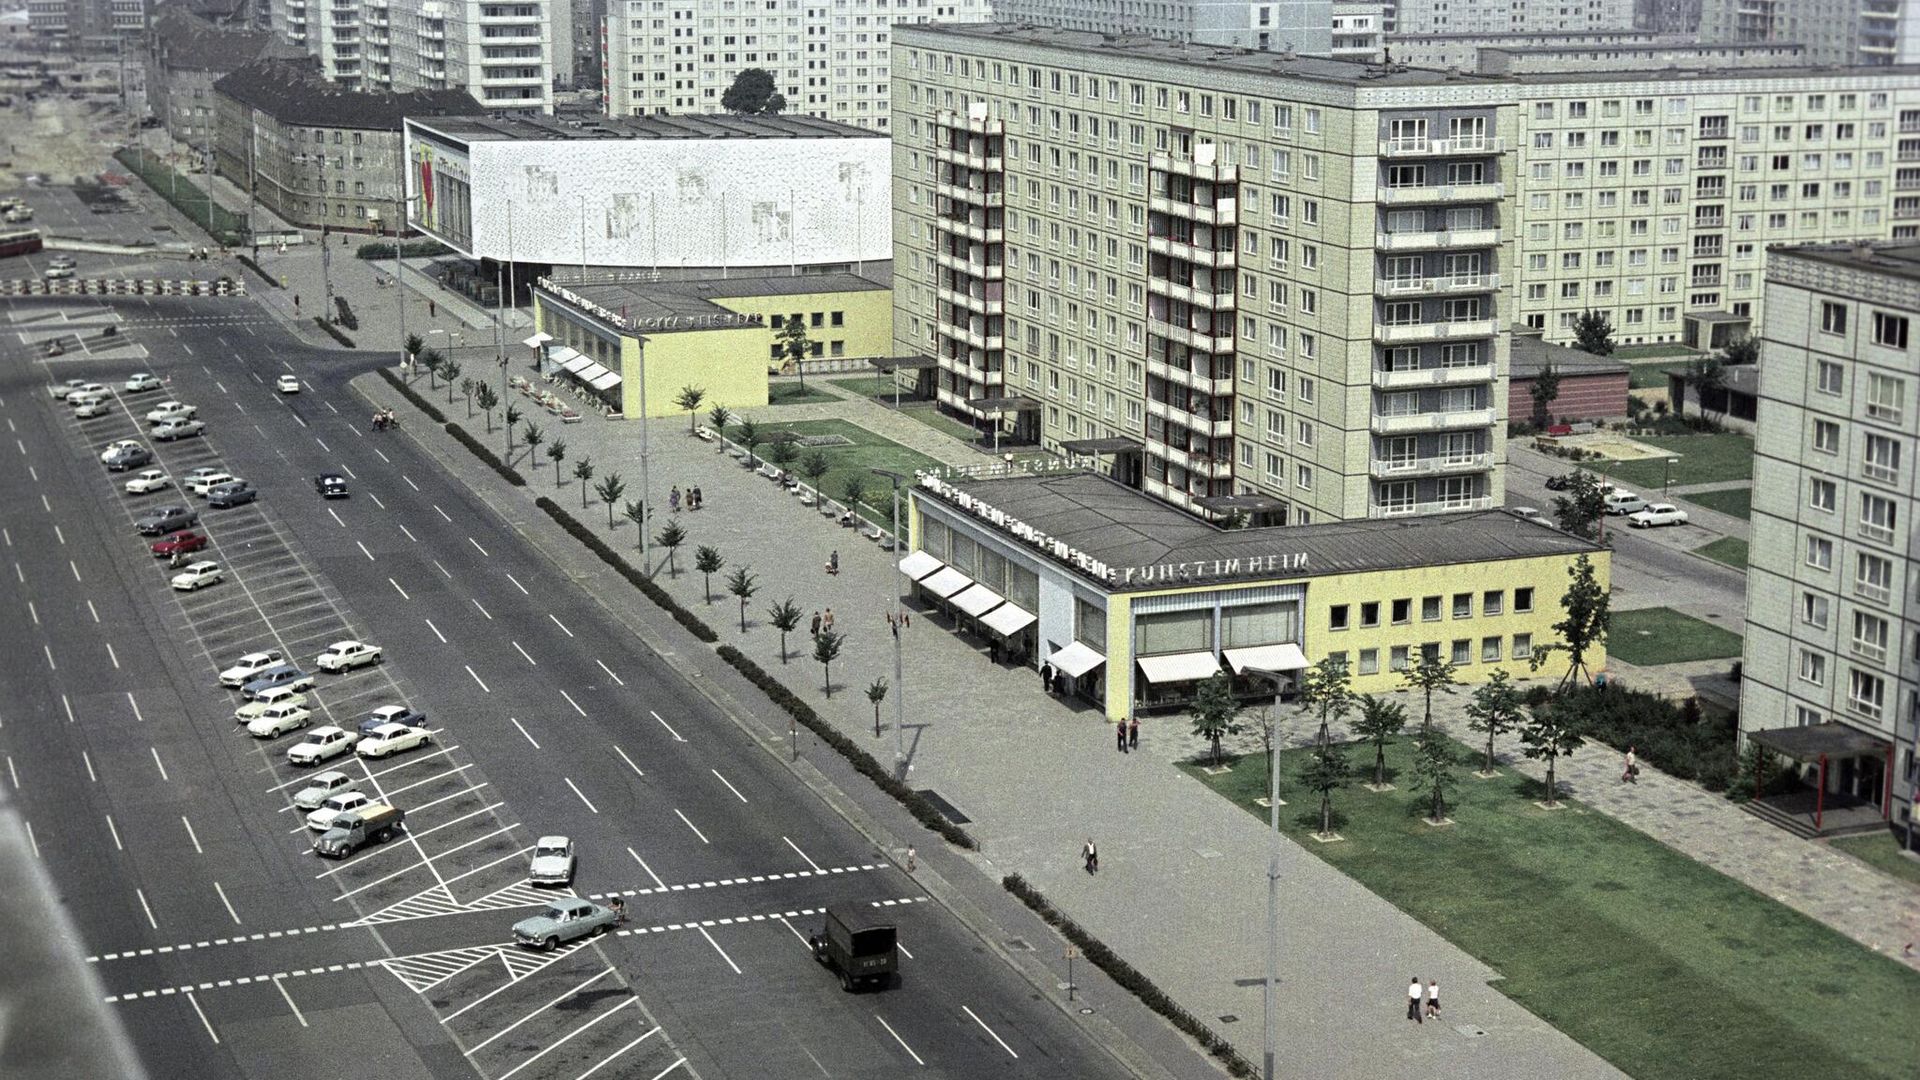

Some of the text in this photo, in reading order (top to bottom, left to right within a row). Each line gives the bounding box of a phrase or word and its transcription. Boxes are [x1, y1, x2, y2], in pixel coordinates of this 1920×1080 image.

[1125, 552, 1310, 583] KUNST IM HEIM
